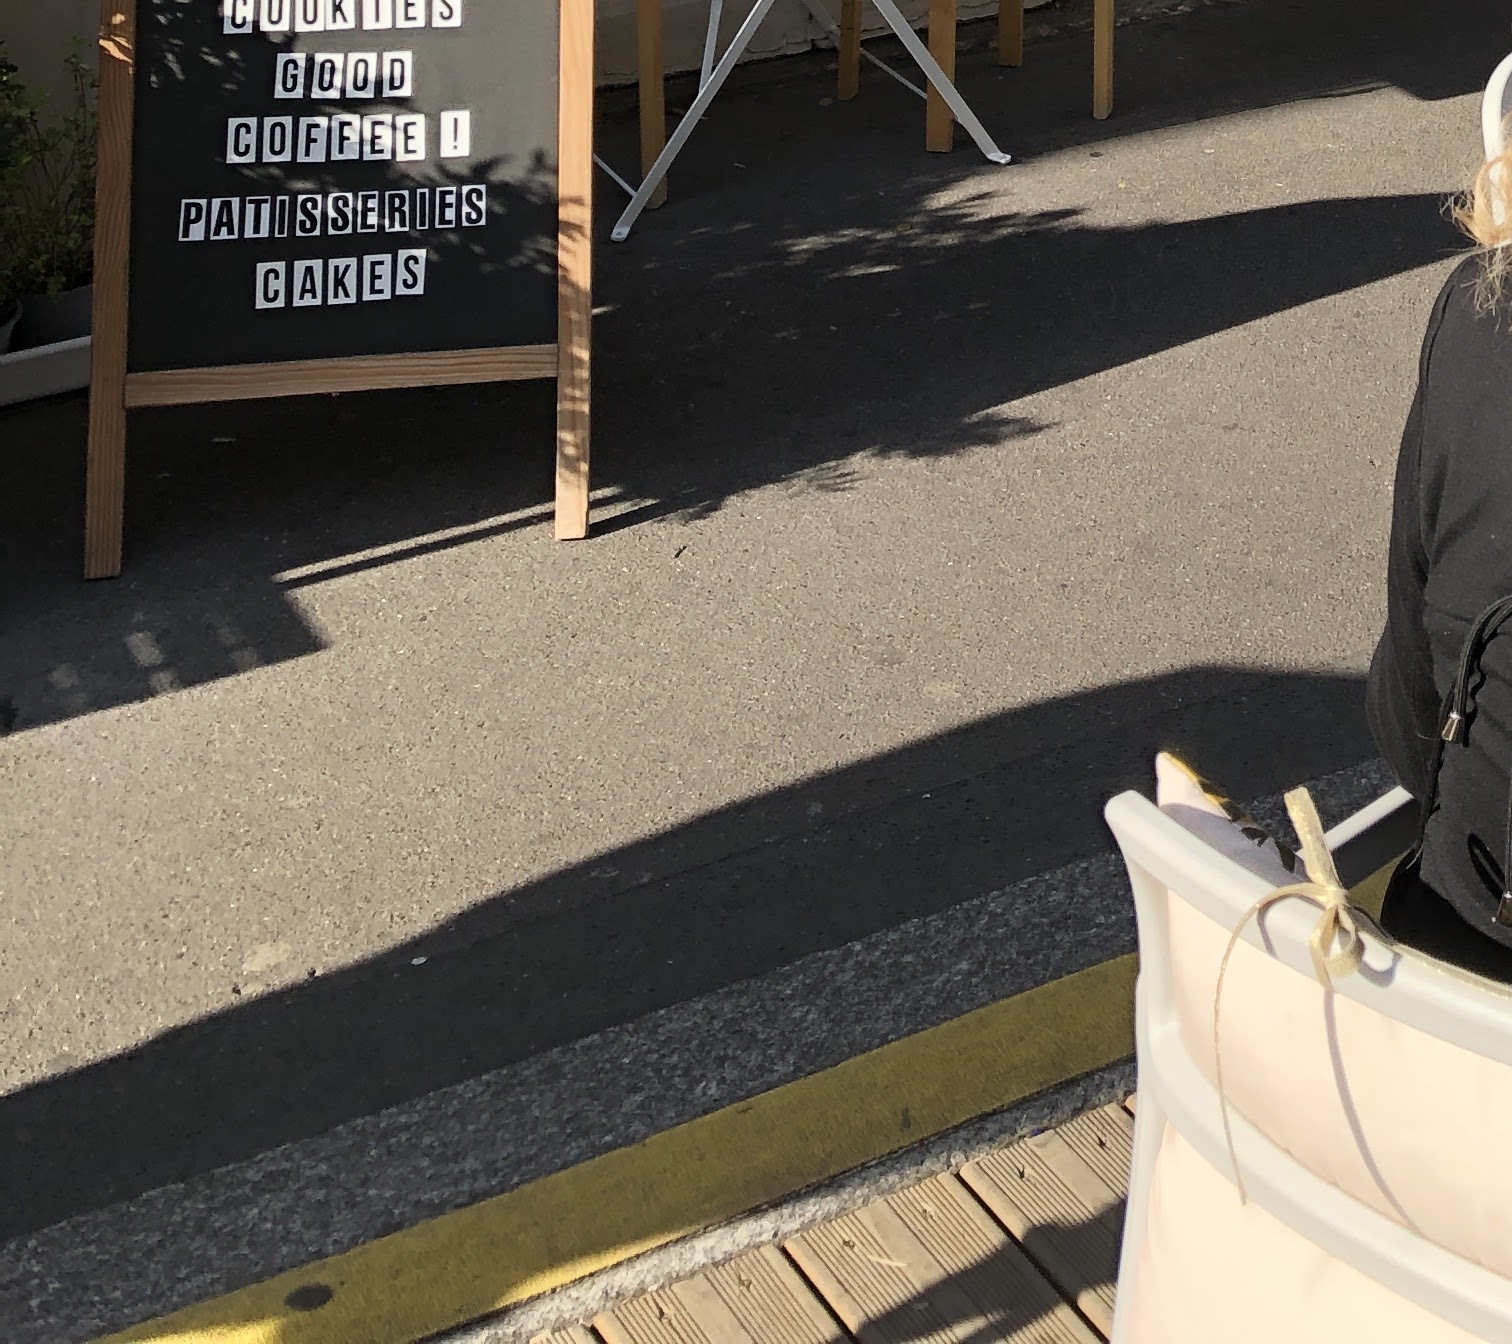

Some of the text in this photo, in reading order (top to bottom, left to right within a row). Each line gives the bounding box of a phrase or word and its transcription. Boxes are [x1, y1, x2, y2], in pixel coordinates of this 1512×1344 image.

[280, 57, 407, 95] GOOD
[233, 119, 419, 158] COFFEE
[184, 188, 485, 238] PATISSERIES
[262, 254, 421, 305] CAKES
